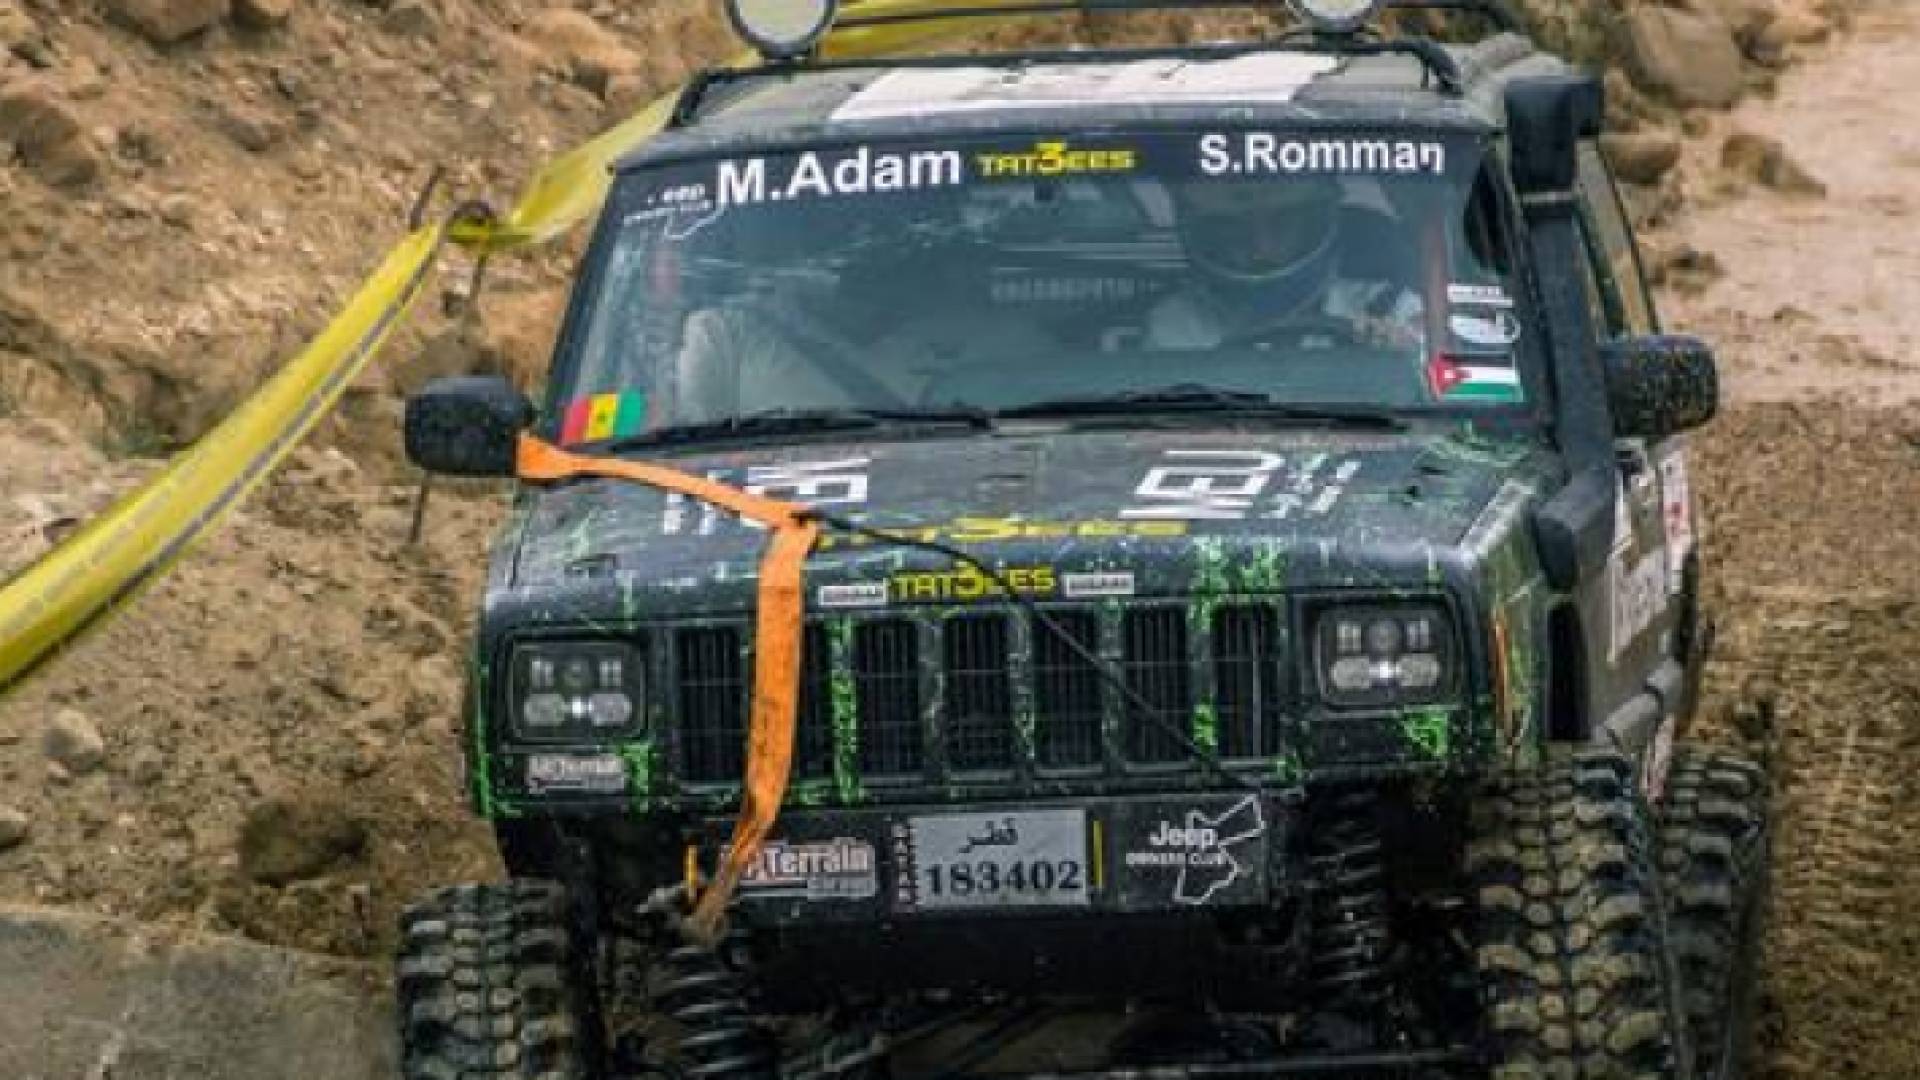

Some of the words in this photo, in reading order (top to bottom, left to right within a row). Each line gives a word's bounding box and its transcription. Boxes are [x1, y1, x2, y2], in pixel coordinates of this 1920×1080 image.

[1200, 133, 1447, 175] S.Romman
[717, 145, 961, 207] M.Adam
[957, 816, 1020, 854] قطر
[1149, 820, 1218, 851] Jeep
[925, 860, 1083, 897] 183402
